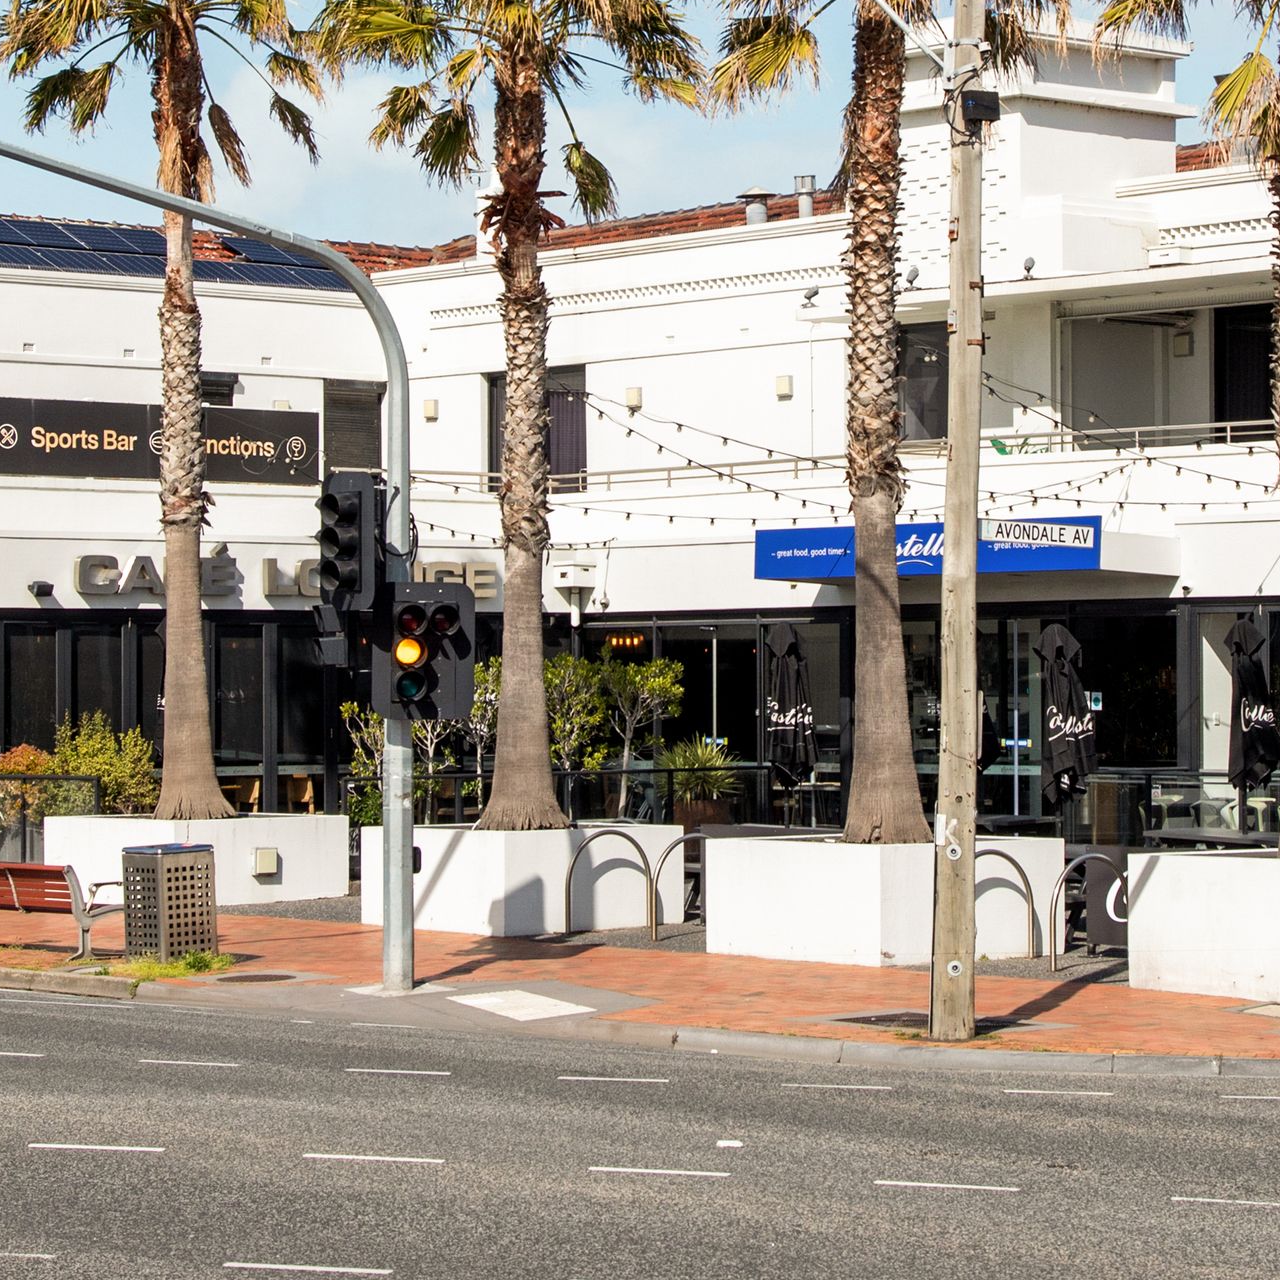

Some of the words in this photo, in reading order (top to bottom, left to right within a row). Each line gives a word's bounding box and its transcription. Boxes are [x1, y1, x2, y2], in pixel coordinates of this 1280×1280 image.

[31, 426, 99, 453] Sports
[103, 429, 138, 451] Bar
[205, 435, 275, 457] nctions
[995, 522, 1066, 543] AVONDALE
[1072, 528, 1090, 544] AV
[777, 550, 792, 559] great
[810, 548, 827, 558] good
[74, 542, 237, 596] CAÉ
